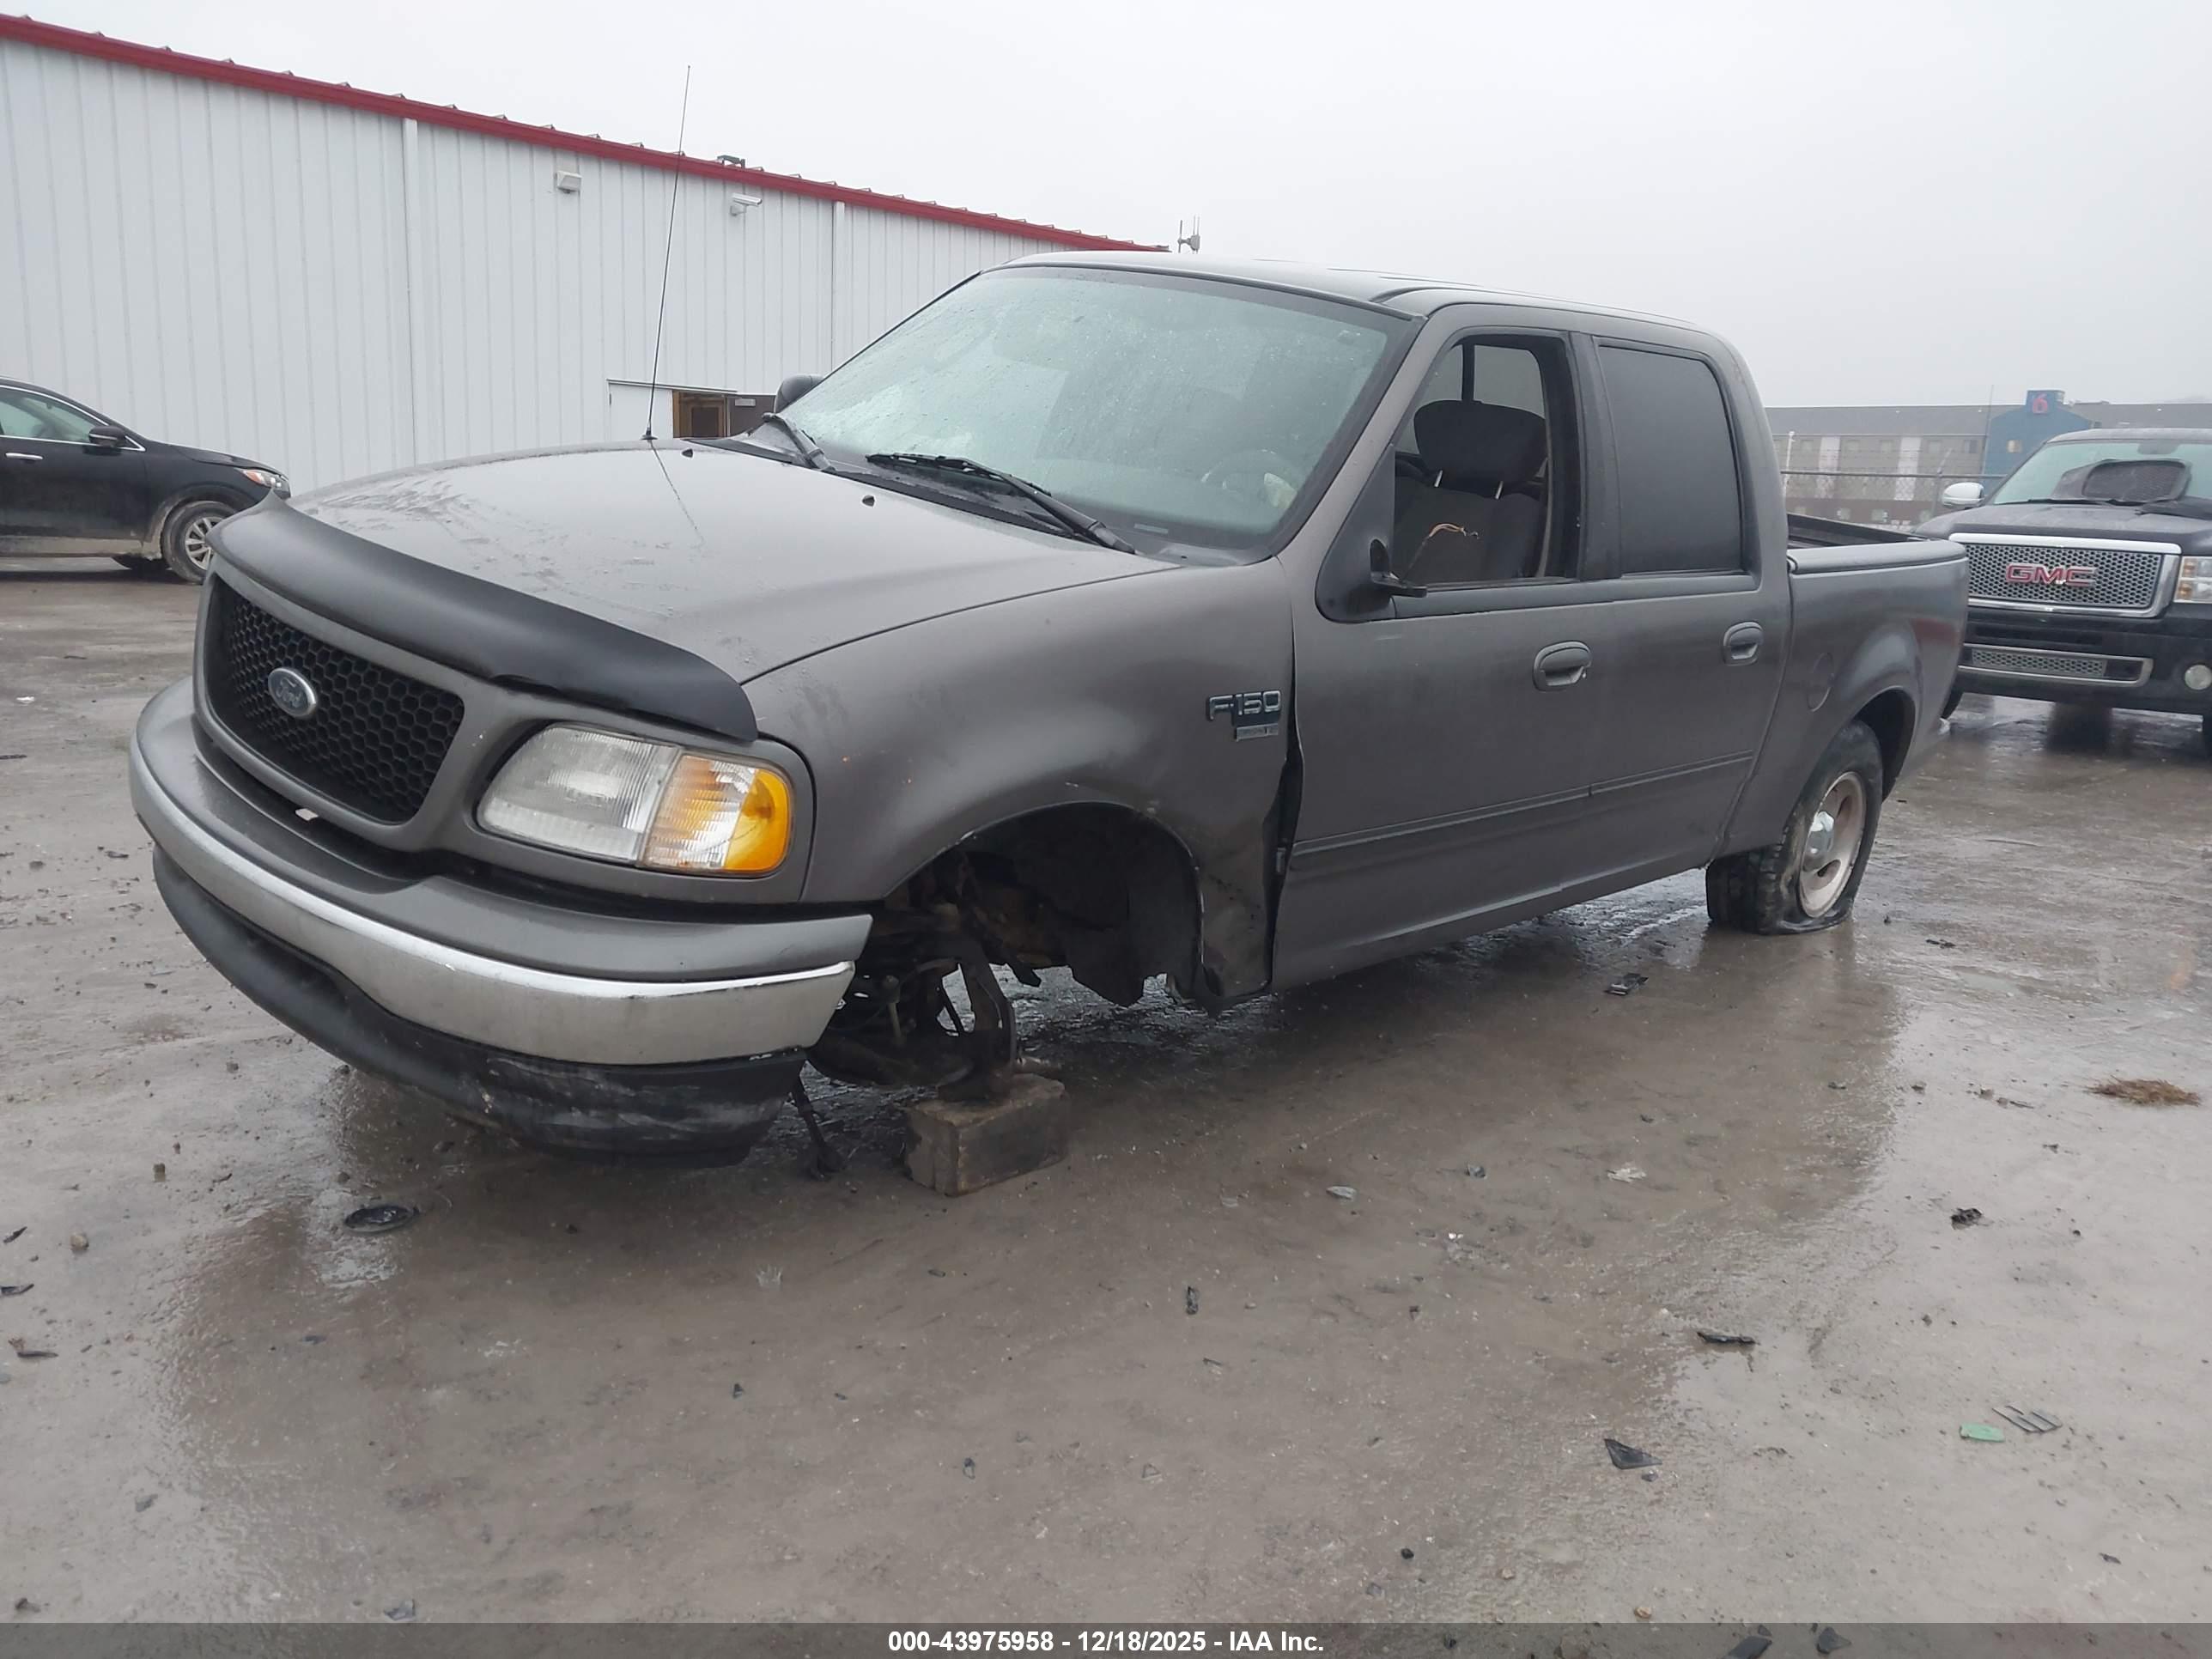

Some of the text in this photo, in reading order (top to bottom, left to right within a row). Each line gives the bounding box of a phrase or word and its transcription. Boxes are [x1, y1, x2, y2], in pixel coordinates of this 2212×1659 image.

[2033, 392, 2048, 414] 6
[2006, 562, 2096, 586] GMC
[276, 676, 302, 708] Ford
